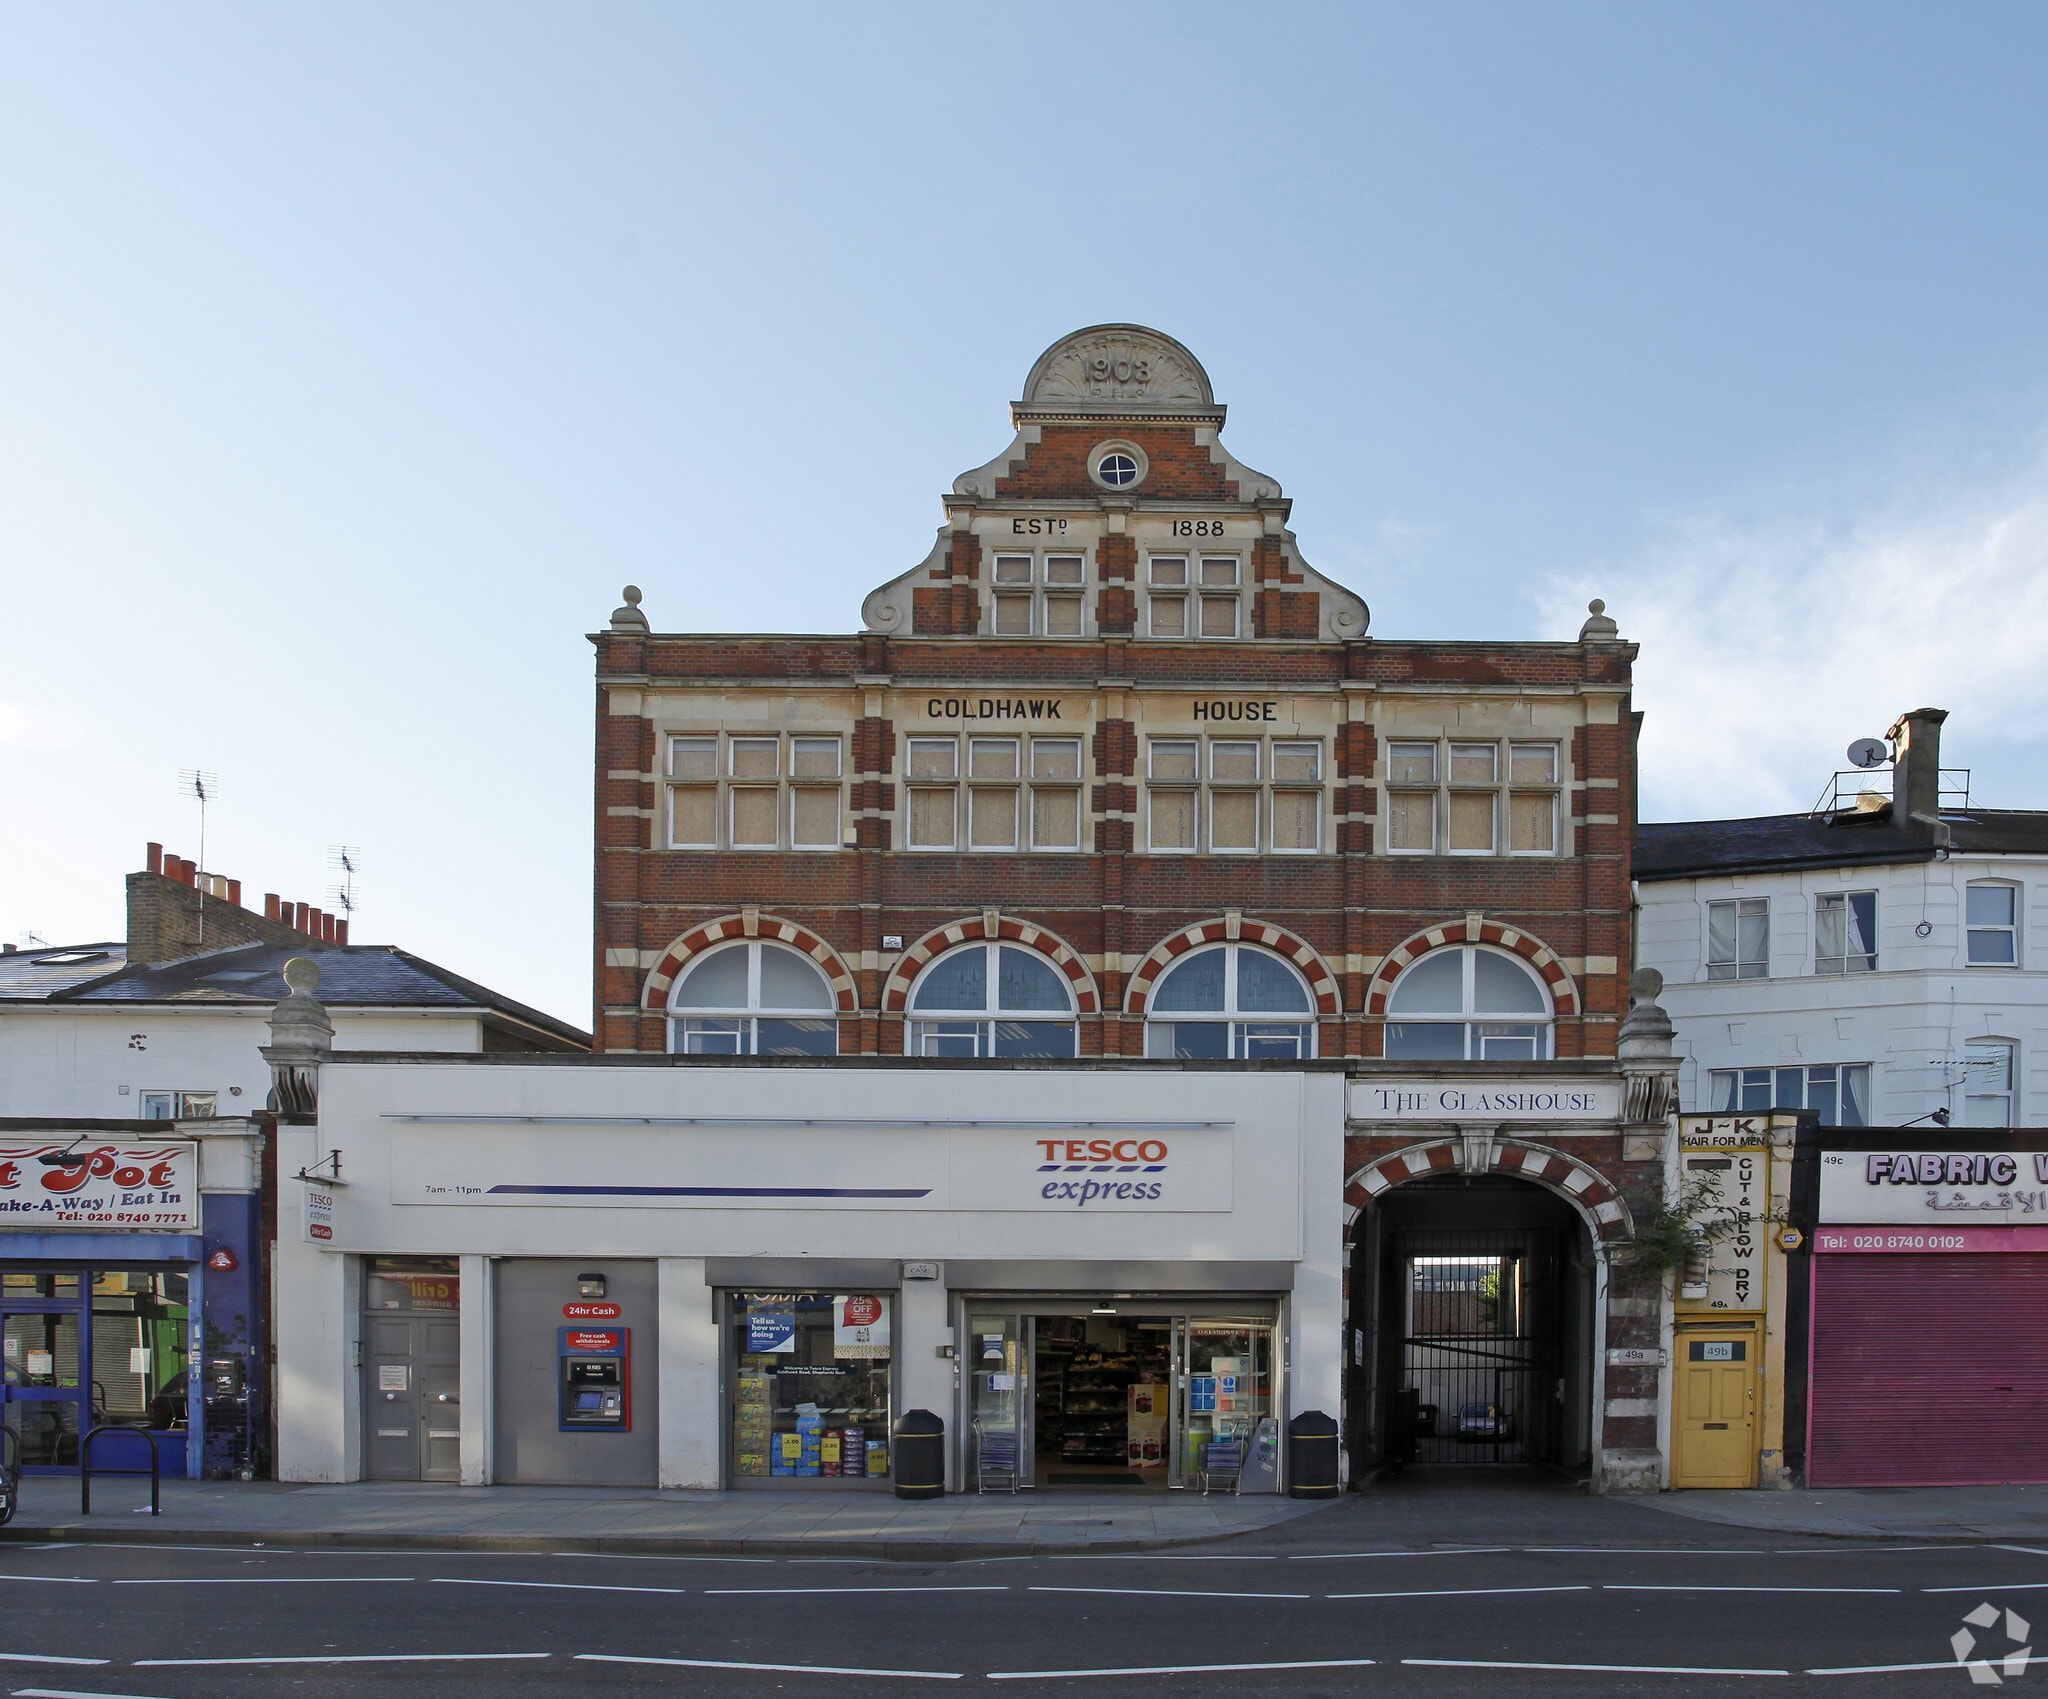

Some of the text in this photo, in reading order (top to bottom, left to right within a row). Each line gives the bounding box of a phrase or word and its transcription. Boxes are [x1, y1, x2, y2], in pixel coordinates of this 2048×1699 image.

[1084, 359, 1153, 382] 1903
[1172, 520, 1225, 536] 1888
[927, 698, 1277, 721] GOLDHAWK HOUSE
[1682, 1136, 1765, 1146] HAIR FOR MEN
[1036, 1139, 1168, 1162] TESCO
[1739, 1157, 1753, 1192] CUT
[1824, 1156, 1844, 1165] 49c
[1866, 1154, 2017, 1186] FABRIC
[425, 1185, 446, 1193] 7am
[455, 1186, 482, 1195] 11pm
[1041, 1179, 1162, 1207] express
[121, 1192, 154, 1206] Eat
[160, 1191, 182, 1204] In
[309, 1192, 333, 1207] TESCO
[56, 1211, 188, 1223] Tel: 020 8740 7771
[1734, 1211, 1753, 1258] BLOW
[1820, 1235, 1965, 1248] Tel: 020 8740 0102
[1735, 1268, 1750, 1302] DRY
[852, 1296, 873, 1305] 25%
[1711, 1300, 1729, 1309] 49A
[569, 1306, 615, 1315] 24hr Cash
[852, 1305, 873, 1313] OFF
[751, 1317, 765, 1325] Tell
[751, 1331, 774, 1339] doing
[1624, 1350, 1644, 1359] 49a
[1707, 1347, 1728, 1356] 49b
